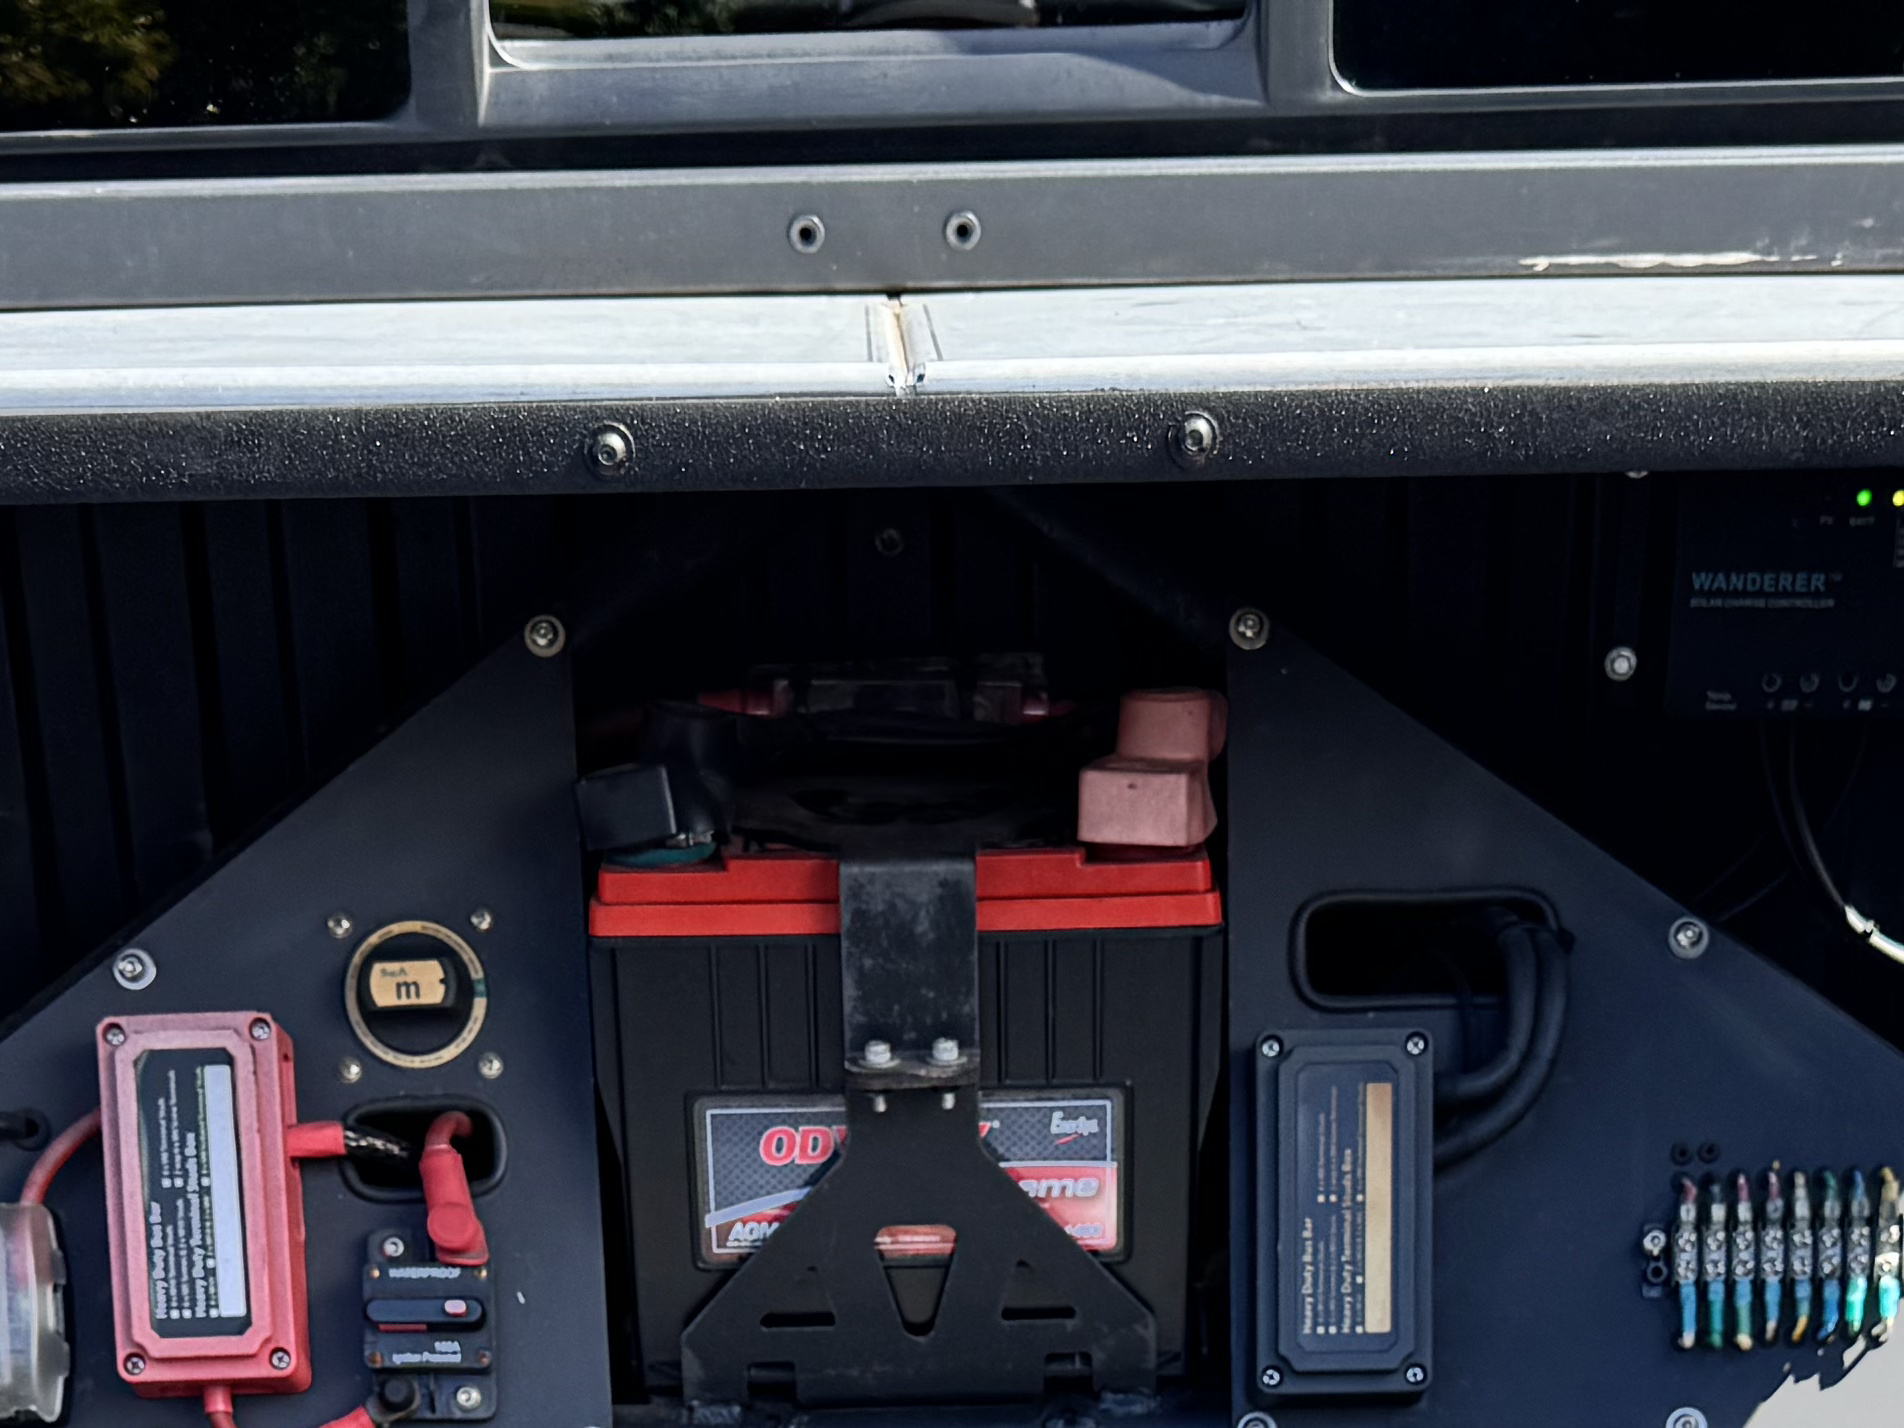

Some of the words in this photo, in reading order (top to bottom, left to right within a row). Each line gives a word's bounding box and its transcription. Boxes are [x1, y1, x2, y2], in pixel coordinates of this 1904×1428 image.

[1692, 572, 1826, 593] WANDERER
[1302, 1263, 1314, 1294] Duty
[1341, 1263, 1354, 1294] Duty
[1302, 1295, 1314, 1334] Heavy
[1341, 1295, 1353, 1334] Heavy
